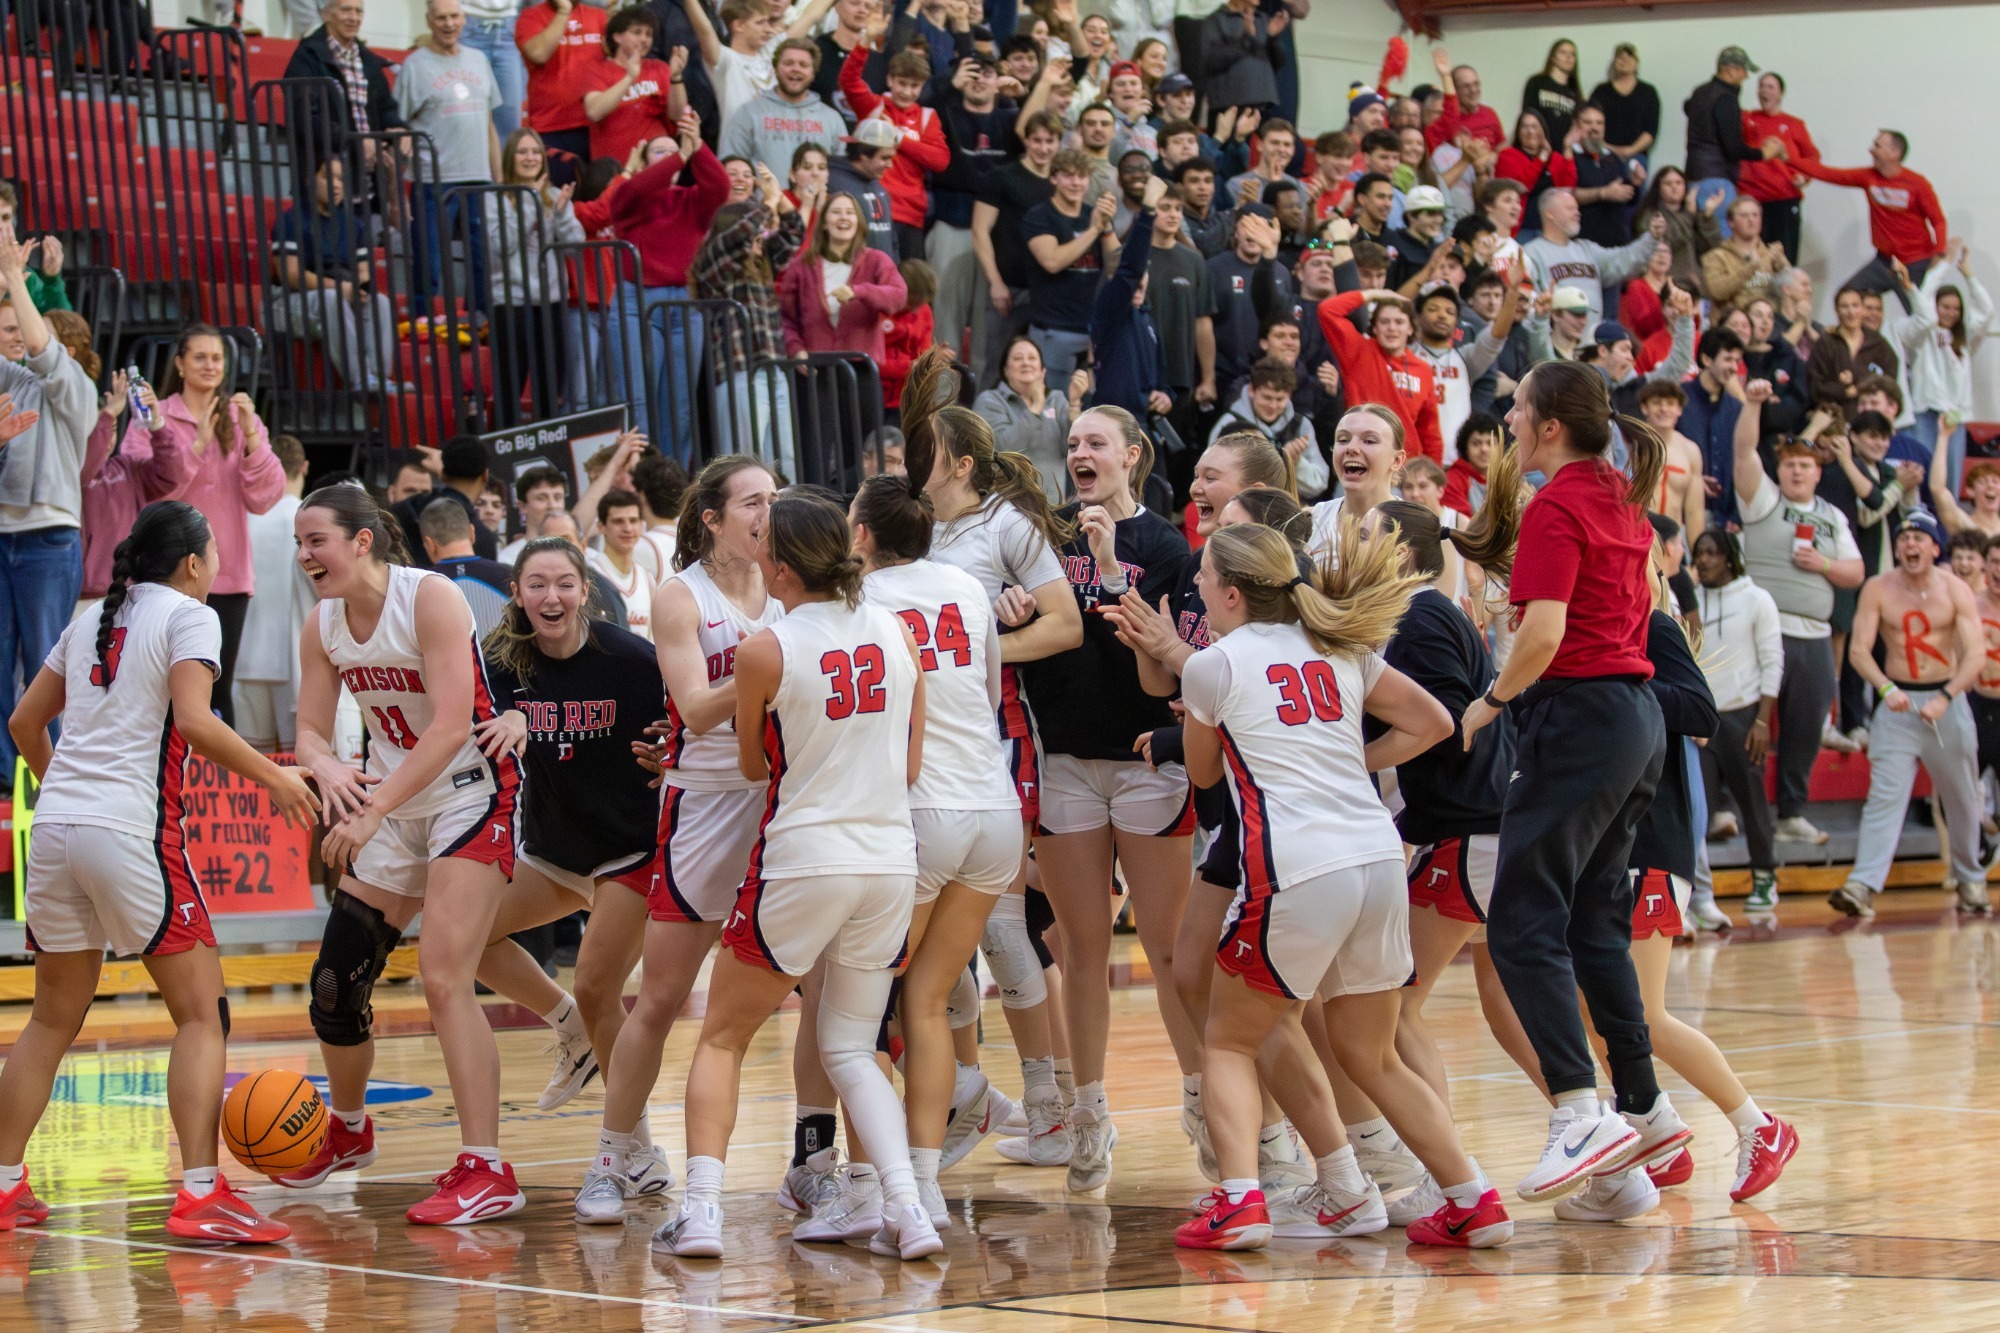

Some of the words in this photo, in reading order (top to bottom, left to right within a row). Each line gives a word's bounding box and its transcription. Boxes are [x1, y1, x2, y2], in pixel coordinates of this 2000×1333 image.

[764, 117, 823, 134] DENISON
[494, 438, 513, 454] Go
[515, 432, 536, 451] Big
[537, 425, 568, 445] Red!
[89, 627, 127, 687] 3
[896, 602, 972, 672] 24
[1903, 609, 1949, 680] R
[819, 643, 886, 721] 32
[1265, 659, 1345, 726] 30
[370, 705, 420, 750] 11
[527, 727, 612, 742] ASKETBALL
[562, 699, 616, 732] RED
[183, 791, 219, 818] OUT
[211, 823, 271, 846] FEELING
[201, 850, 275, 897] #22
